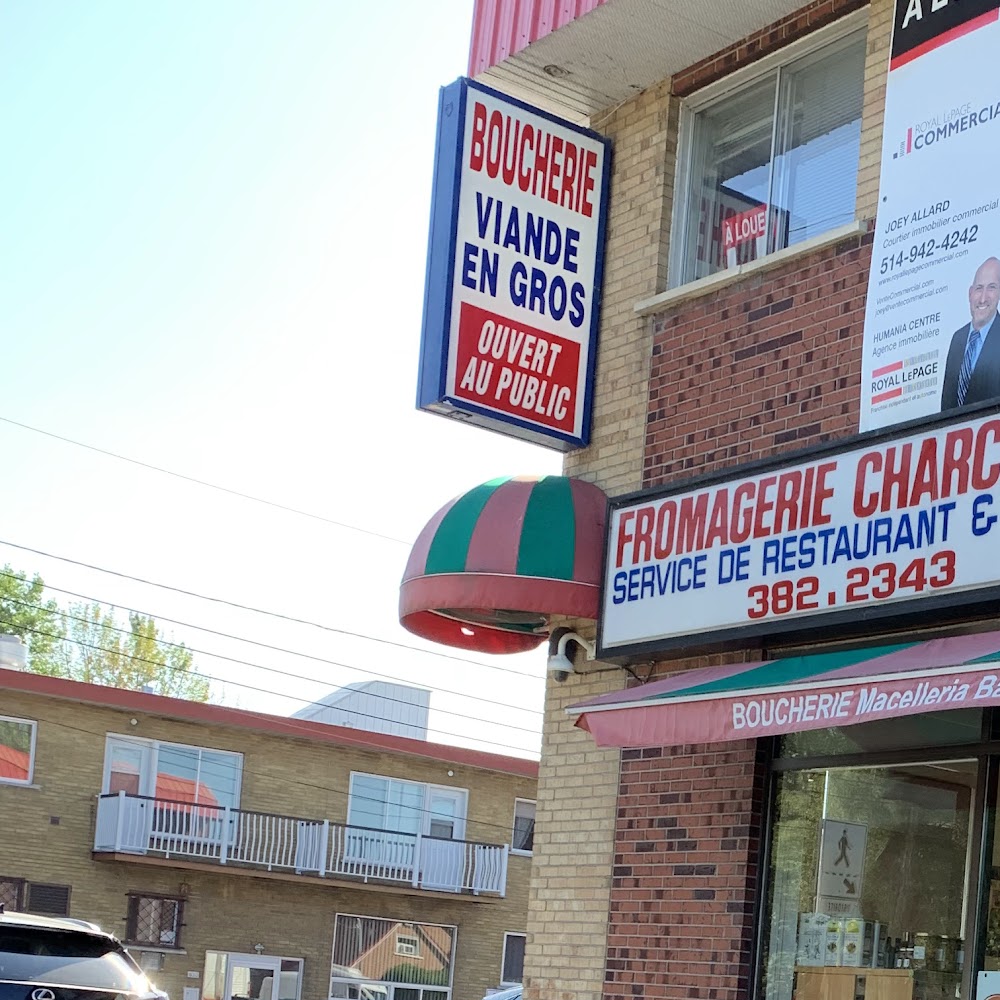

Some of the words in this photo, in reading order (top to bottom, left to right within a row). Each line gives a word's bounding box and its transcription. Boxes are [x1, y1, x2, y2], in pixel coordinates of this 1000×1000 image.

[915, 116, 942, 134] ROYAL
[469, 101, 598, 219] BOUCHERIE
[476, 191, 581, 275] VIANDE
[725, 221, 734, 246] À
[735, 211, 767, 241] LOUE
[883, 232, 911, 249] Courtier
[912, 216, 951, 239] immobilier
[952, 199, 999, 223] commercial
[885, 215, 909, 234] JOEY
[911, 200, 950, 224] ALLARD
[879, 224, 980, 275] 514-942-4242
[461, 242, 499, 298] EN
[509, 260, 586, 328] GROS
[477, 319, 563, 378] OUVERT
[872, 340, 898, 358] Agence
[899, 327, 940, 349] immobilière
[873, 320, 907, 343] HUMANIA
[908, 312, 941, 334] CENTRE
[460, 356, 494, 398] AU
[494, 368, 572, 422] PUBLIC
[871, 374, 900, 393] ROYAL
[615, 460, 838, 568] FROMAGERIE
[613, 555, 707, 605] SERVICE
[718, 546, 750, 584] DE
[762, 502, 956, 576] RESTAURANT
[971, 493, 998, 537] &
[747, 550, 956, 619] 382.2343
[732, 690, 855, 730] BOUCHERIE
[855, 679, 968, 716] Macelleria
